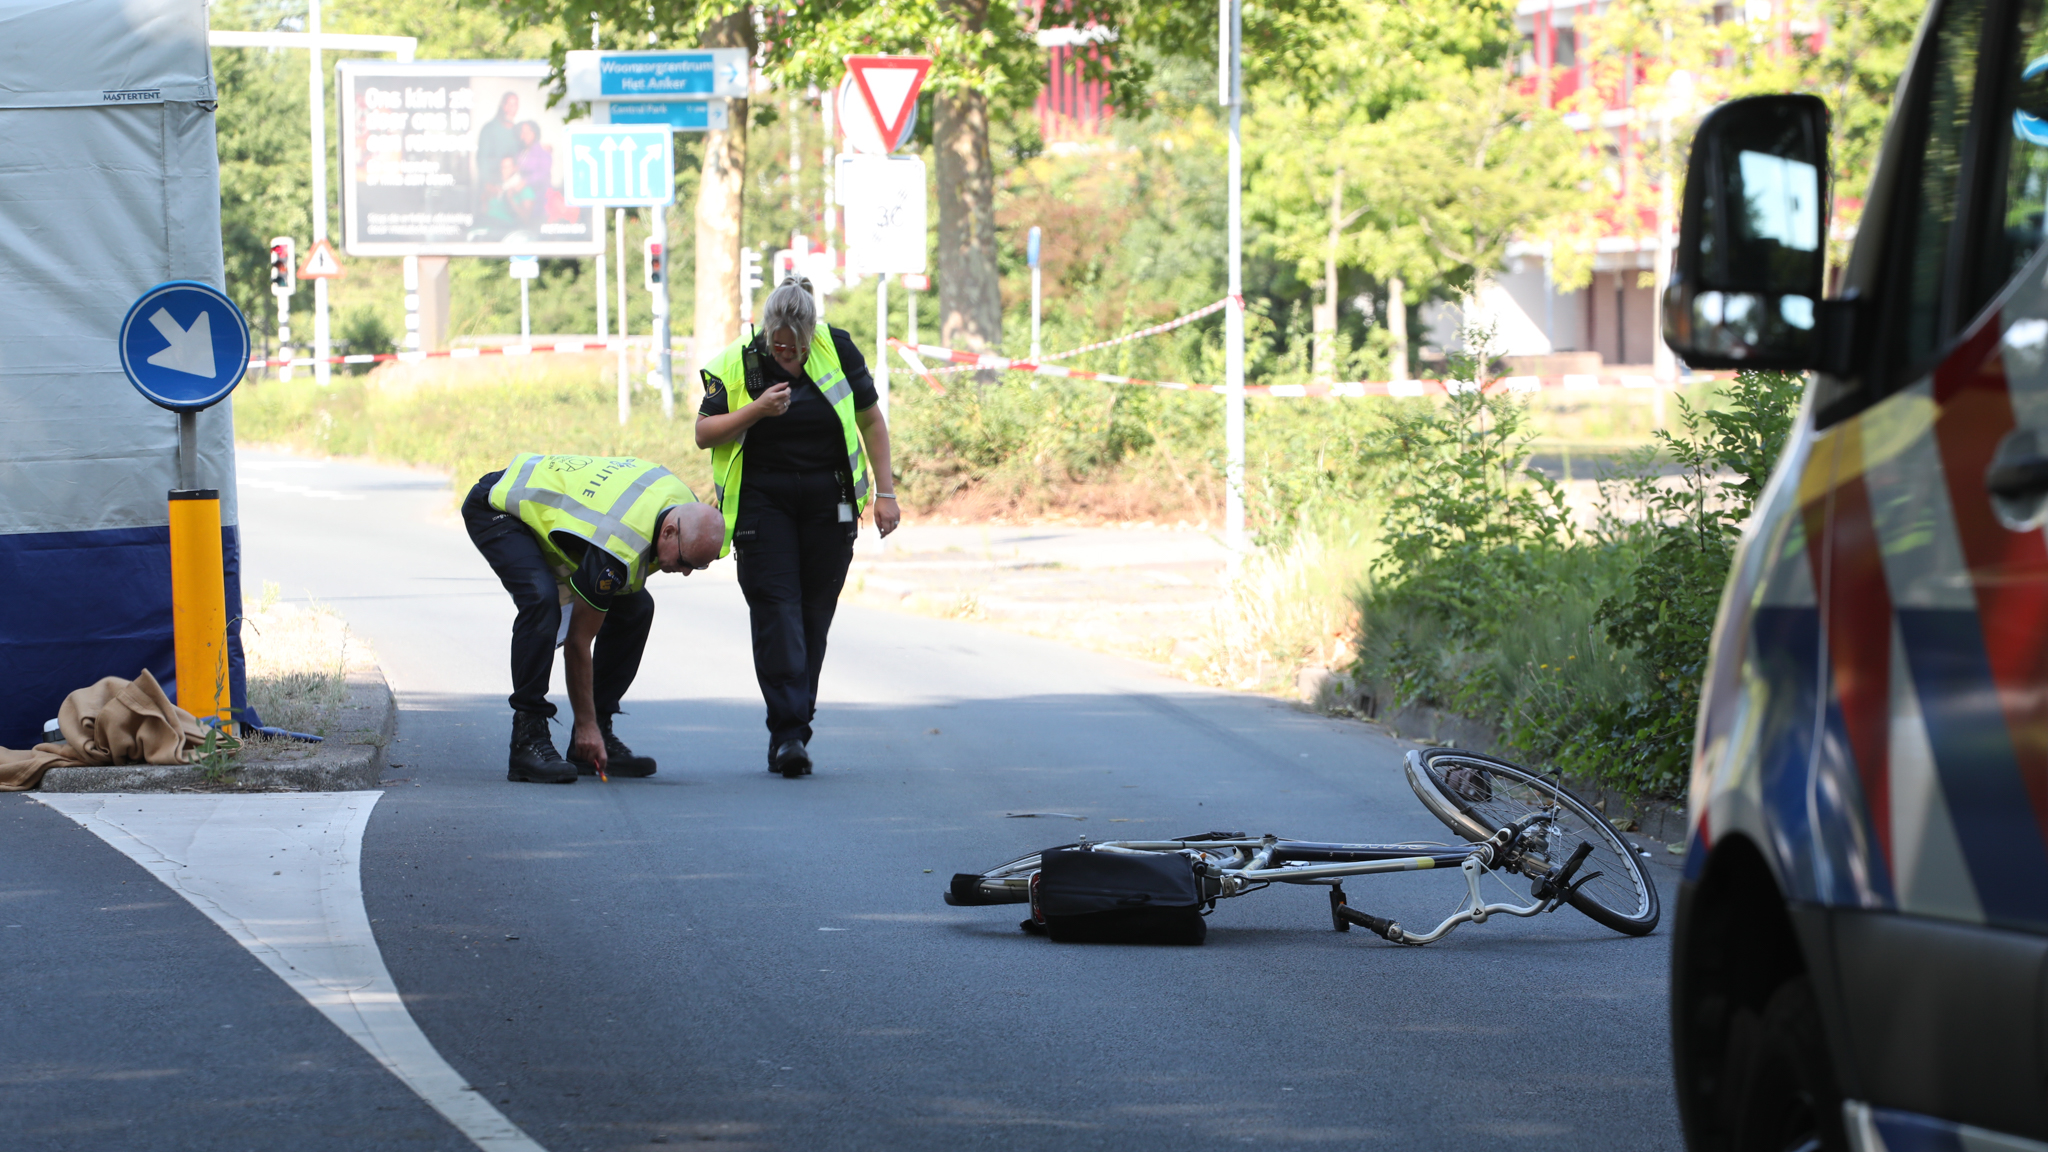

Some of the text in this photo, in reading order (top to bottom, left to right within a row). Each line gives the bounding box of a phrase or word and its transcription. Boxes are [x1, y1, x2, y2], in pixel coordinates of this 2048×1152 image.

[602, 60, 713, 76] Woonzorgcentrum
[622, 77, 687, 90] Het Anker
[103, 92, 160, 101] MASTERTENT
[365, 87, 402, 109] Ons
[405, 87, 446, 109] kind
[411, 112, 447, 131] ons
[450, 109, 470, 130] in
